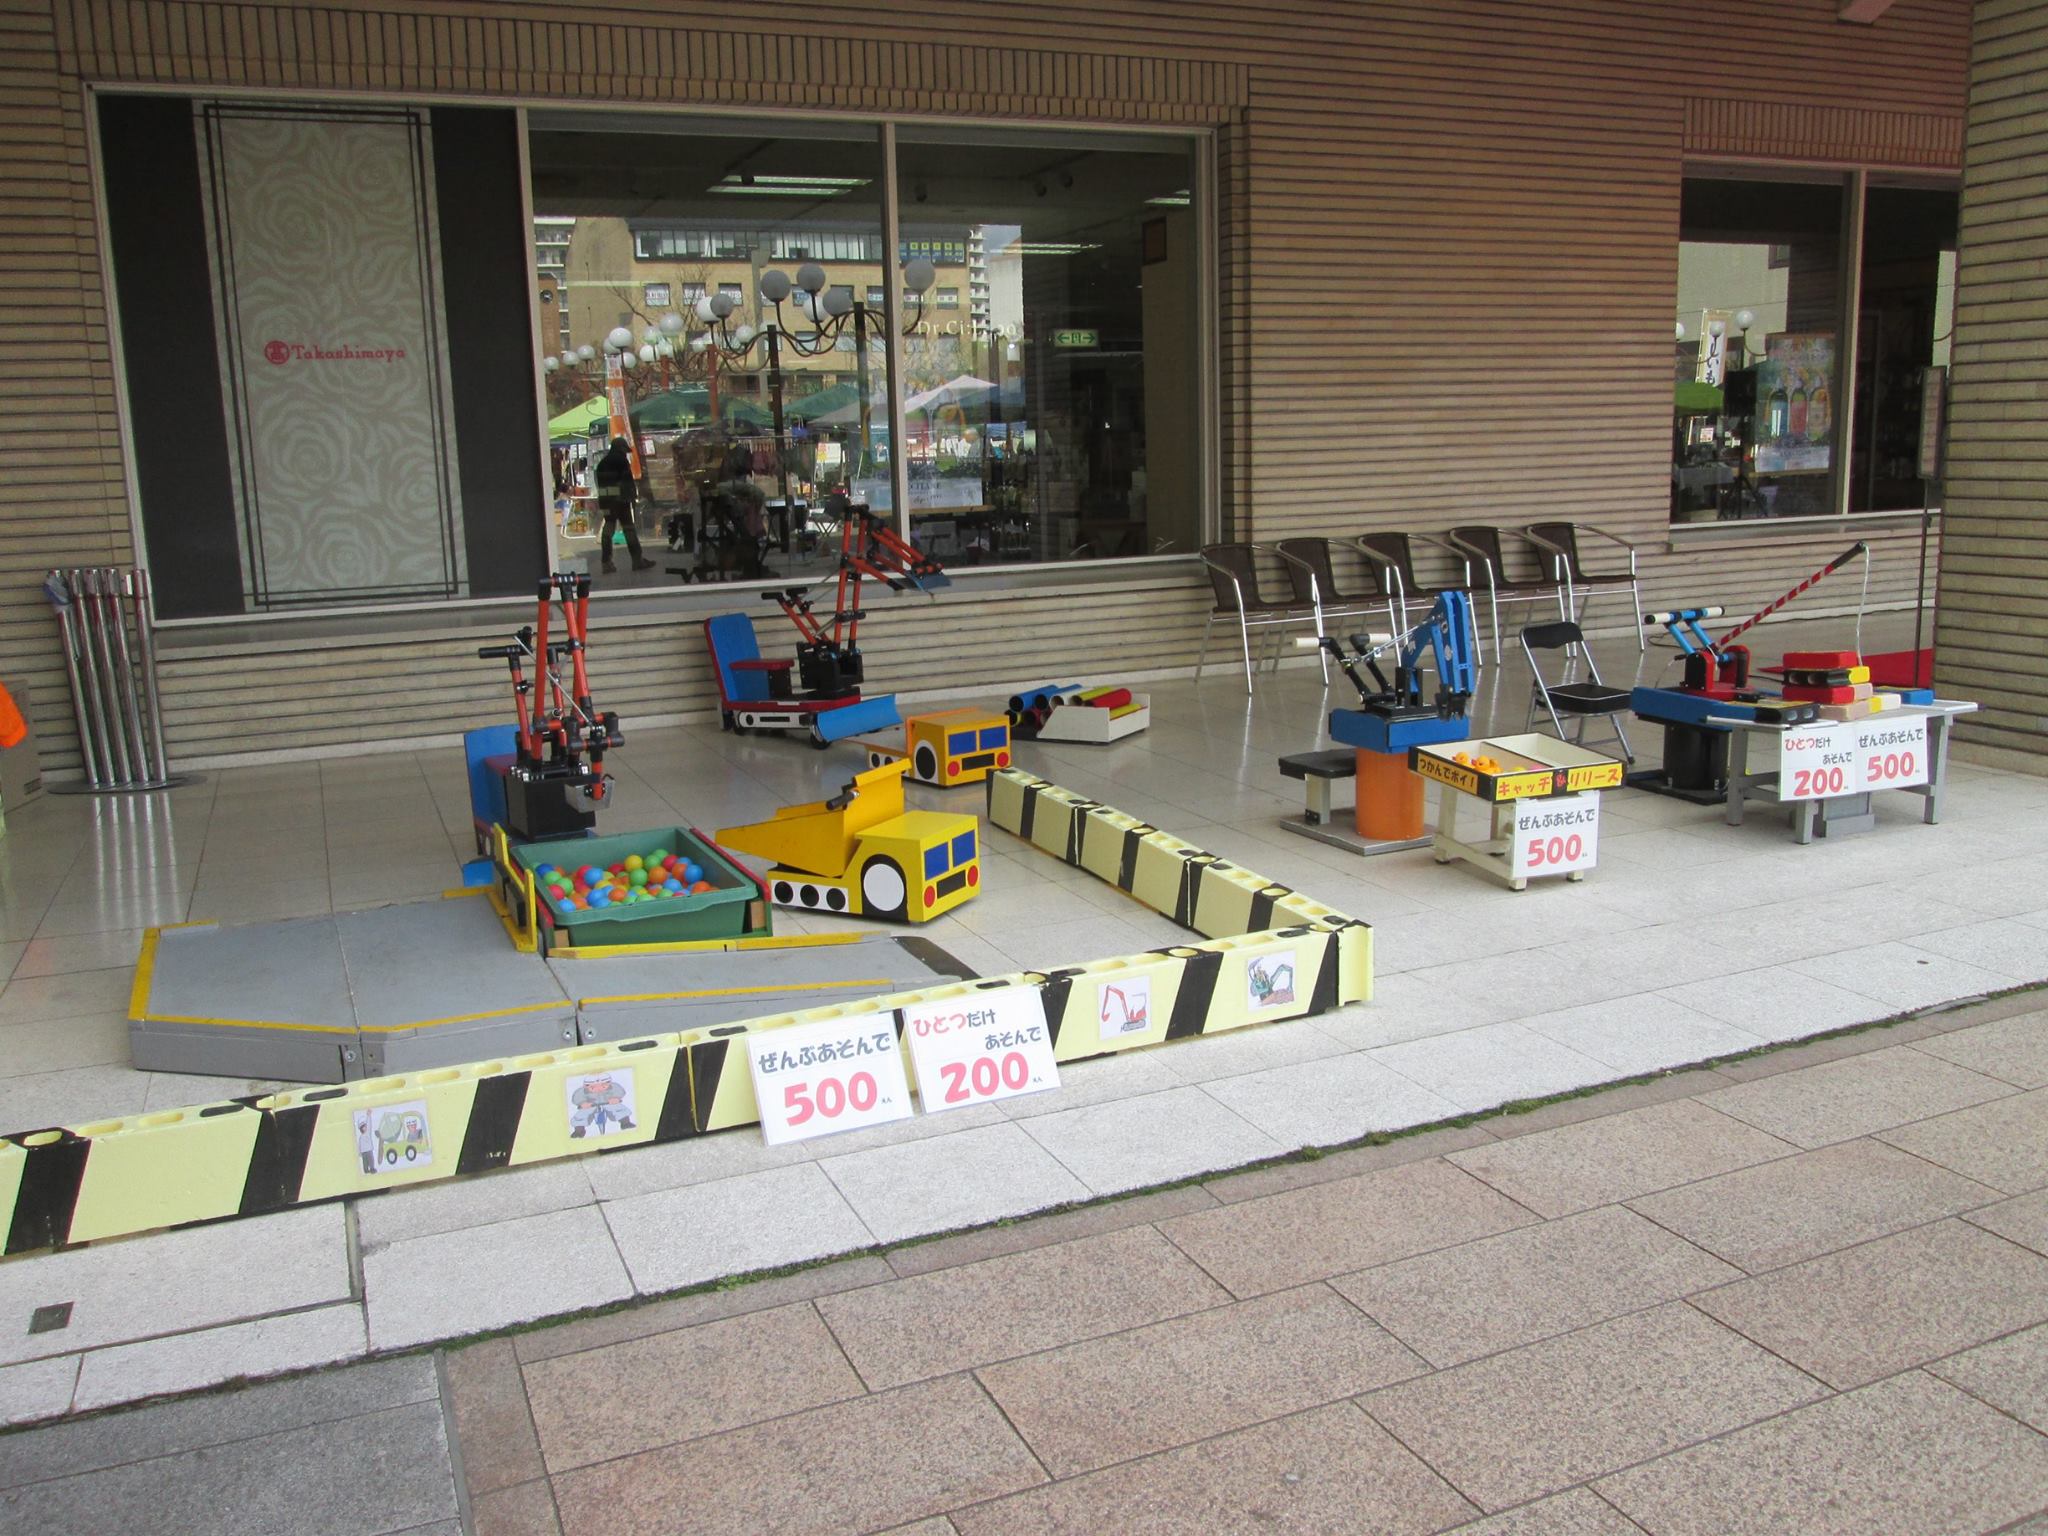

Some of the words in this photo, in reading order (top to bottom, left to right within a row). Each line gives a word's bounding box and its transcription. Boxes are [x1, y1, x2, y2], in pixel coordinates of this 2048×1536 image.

[290, 344, 405, 363] Takashimaya
[1784, 736, 1831, 751] ひとつだけ
[1858, 728, 1923, 748] ぜんぶあそんで
[1822, 751, 1853, 765] あそんで
[1867, 752, 1914, 782] 500
[1793, 767, 1843, 797] 200
[1519, 808, 1595, 831] ぜんぶあそんで
[1527, 834, 1582, 867] 500
[913, 1008, 996, 1037] ひとつだけ
[984, 1026, 1042, 1050] あそんで
[758, 1032, 891, 1074] ぜんぶあそんで
[940, 1052, 1029, 1104] 200
[784, 1071, 878, 1127] 500
